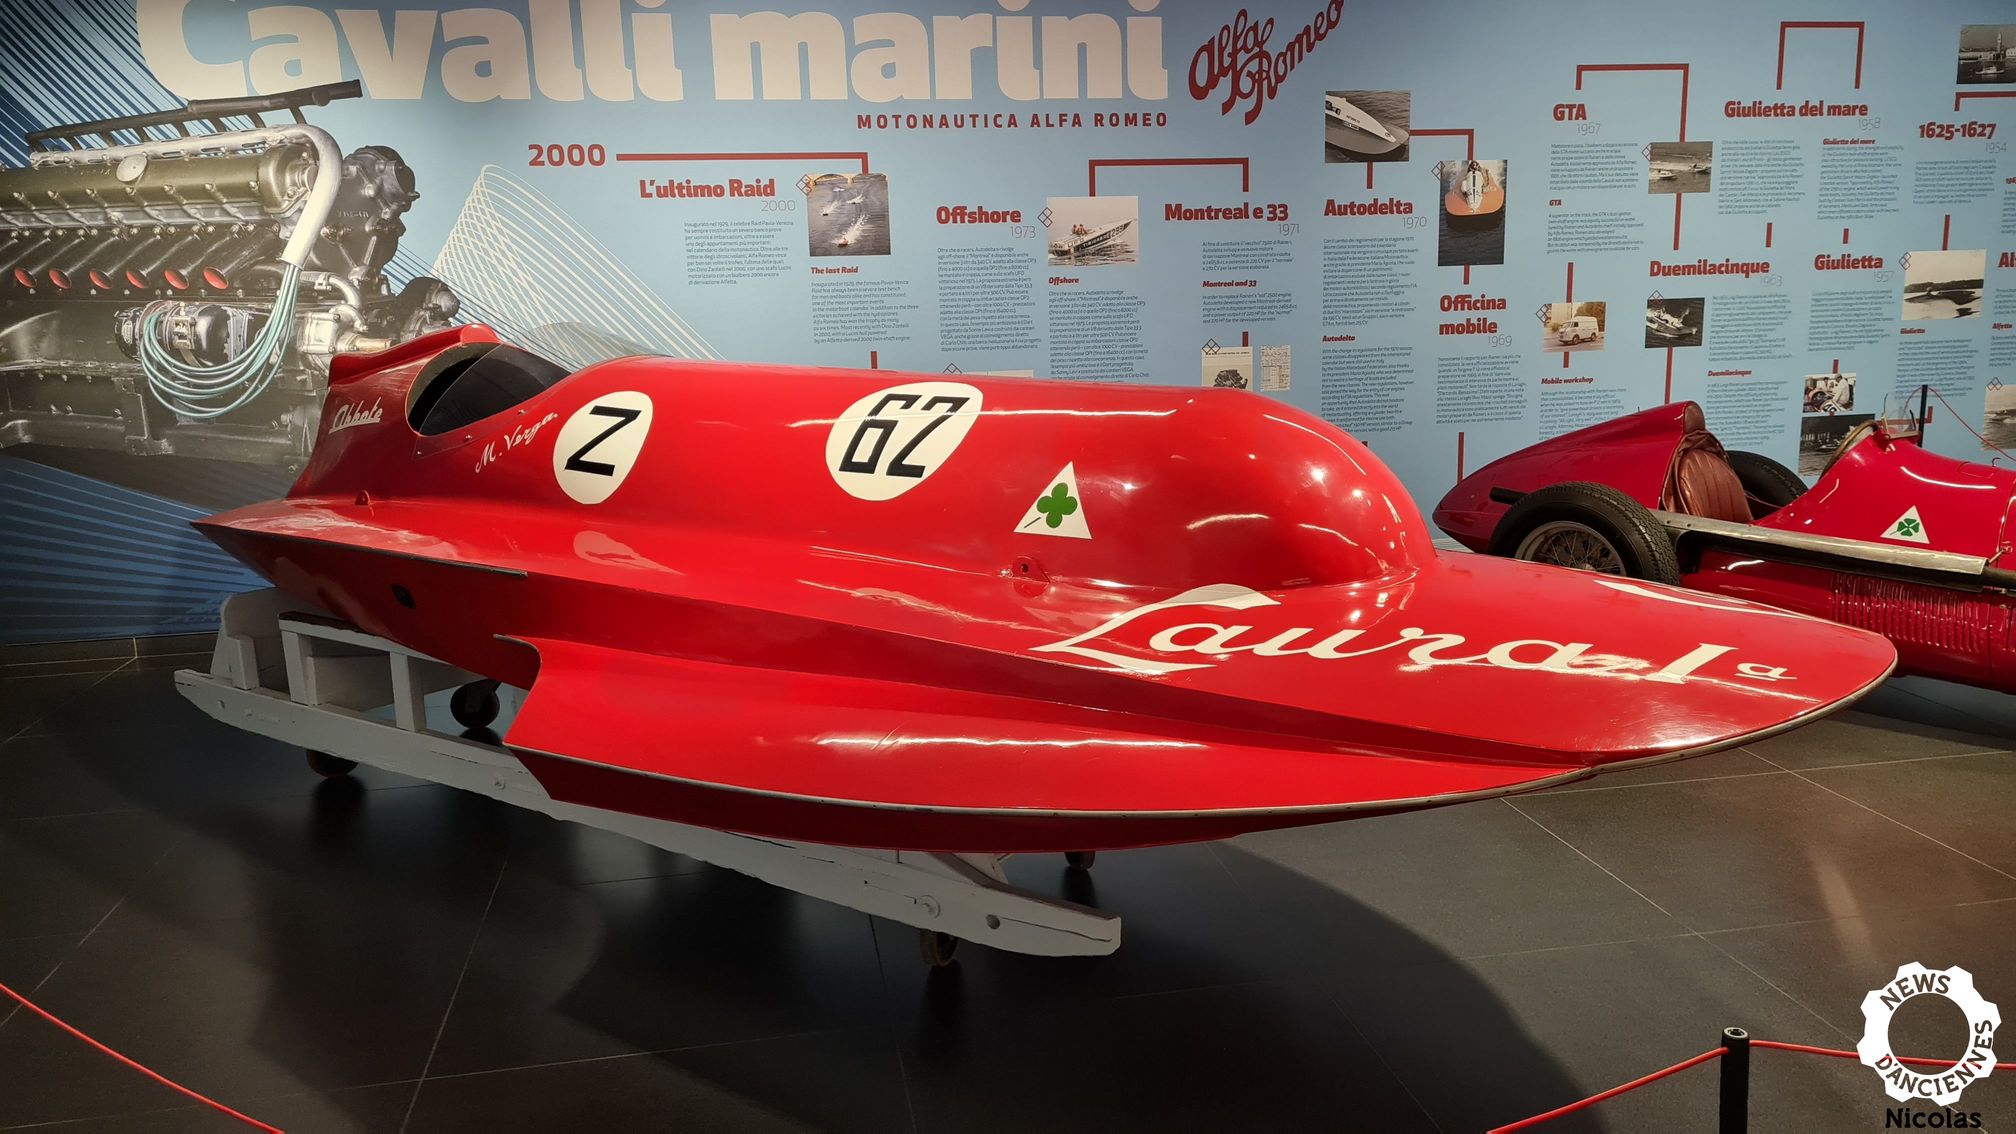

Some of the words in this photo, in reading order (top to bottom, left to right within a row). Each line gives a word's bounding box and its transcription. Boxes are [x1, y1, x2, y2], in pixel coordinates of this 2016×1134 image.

[136, 0, 683, 102] Cavalli
[710, 0, 1168, 101] marini
[1188, 8, 1275, 116] Alfa
[1236, 0, 1345, 126] Romeo
[1553, 103, 1587, 121] GTA
[1724, 101, 1796, 118] Giulietta
[1798, 100, 1824, 117] del
[1827, 103, 1868, 117] mare
[857, 113, 1018, 129] MOTONAUTICA
[1030, 112, 1082, 128] ALFA
[1094, 112, 1168, 128] ROMEO
[1577, 121, 1601, 136] 1967
[1857, 117, 1881, 131] 1958
[1919, 121, 1997, 140] 1625-1627
[528, 144, 606, 167] 2000
[1986, 141, 2007, 154] 1954
[640, 179, 725, 198] L'ultimo
[729, 178, 776, 197] Raid
[761, 199, 796, 212] 2000
[1164, 202, 1250, 221] Montreal
[1252, 206, 1264, 219] e
[1266, 203, 1289, 222] 33
[1324, 198, 1413, 217] Autodelta
[936, 206, 1021, 224] Offshore
[1403, 217, 1427, 229] 1970
[1011, 225, 1036, 239] 1973
[1278, 223, 1300, 237] 1971
[1650, 258, 1770, 278] Duemilacinque
[1814, 254, 1884, 271] Giulietta
[1998, 251, 2016, 268] Al
[811, 267, 825, 275] The
[1873, 270, 1895, 283] 1957
[1049, 277, 1080, 286] Offshore
[1248, 280, 1257, 288] 33
[1760, 273, 1783, 287] 1963
[1440, 293, 1507, 312] Officina
[1439, 317, 1498, 335] mobile
[1900, 327, 1926, 335] Giulietta
[1488, 334, 1512, 347] 1969
[1541, 377, 1563, 385] Mobile
[1563, 376, 1594, 384] workshop
[1708, 369, 1752, 377] Duemilacinque
[838, 393, 971, 478] 62
[475, 441, 503, 473] M.
[1027, 583, 1630, 678] Laura
